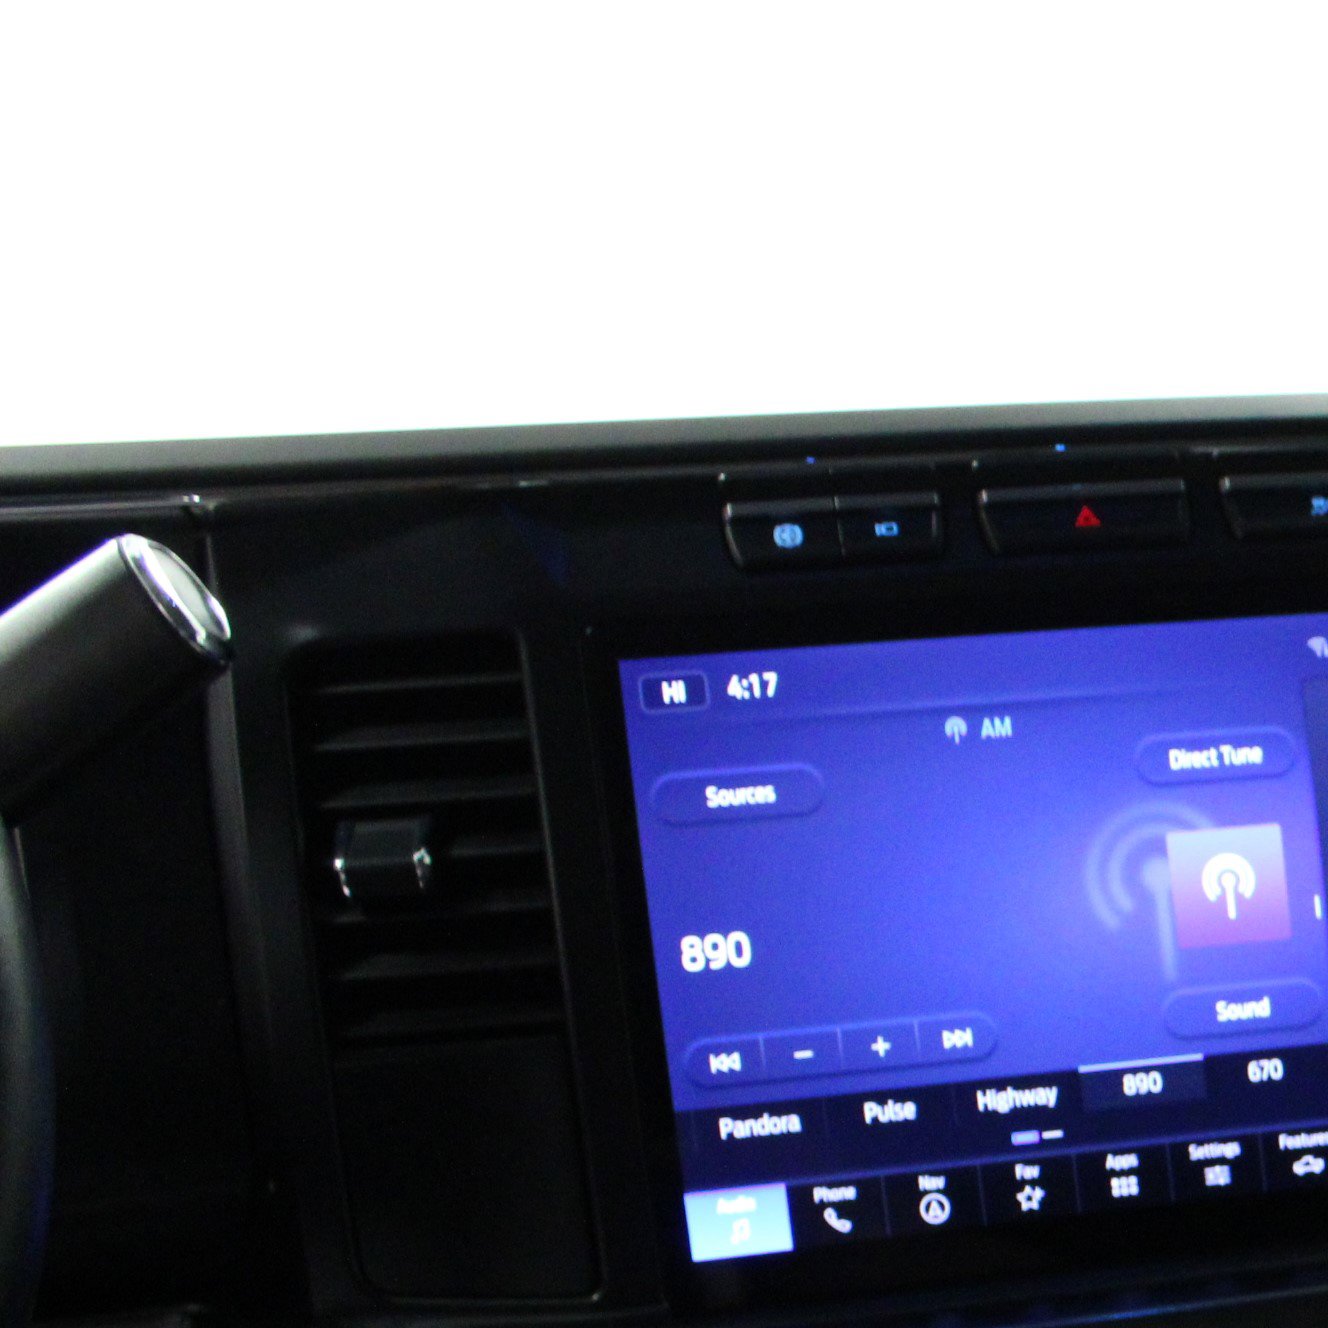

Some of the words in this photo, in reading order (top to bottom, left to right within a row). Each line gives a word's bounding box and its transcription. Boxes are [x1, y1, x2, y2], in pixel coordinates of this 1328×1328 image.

[661, 681, 687, 704] HI
[727, 671, 778, 700] 4:17
[981, 716, 1013, 739] AM
[1169, 748, 1218, 770] Direct
[1220, 745, 1262, 767] Tune
[705, 785, 776, 808] Sources
[680, 931, 751, 972] 890
[1216, 996, 1270, 1022] Sound
[1247, 1058, 1283, 1082] 670
[1122, 1071, 1163, 1096] 890
[977, 1086, 1058, 1113] Highway
[863, 1100, 917, 1124] Pulse
[719, 1112, 802, 1140] Pandora
[1105, 1152, 1138, 1171] Apps
[1189, 1141, 1241, 1162] Settings
[918, 1175, 945, 1190] Nav
[1015, 1163, 1040, 1180] Fav
[813, 1186, 856, 1203] Phone
